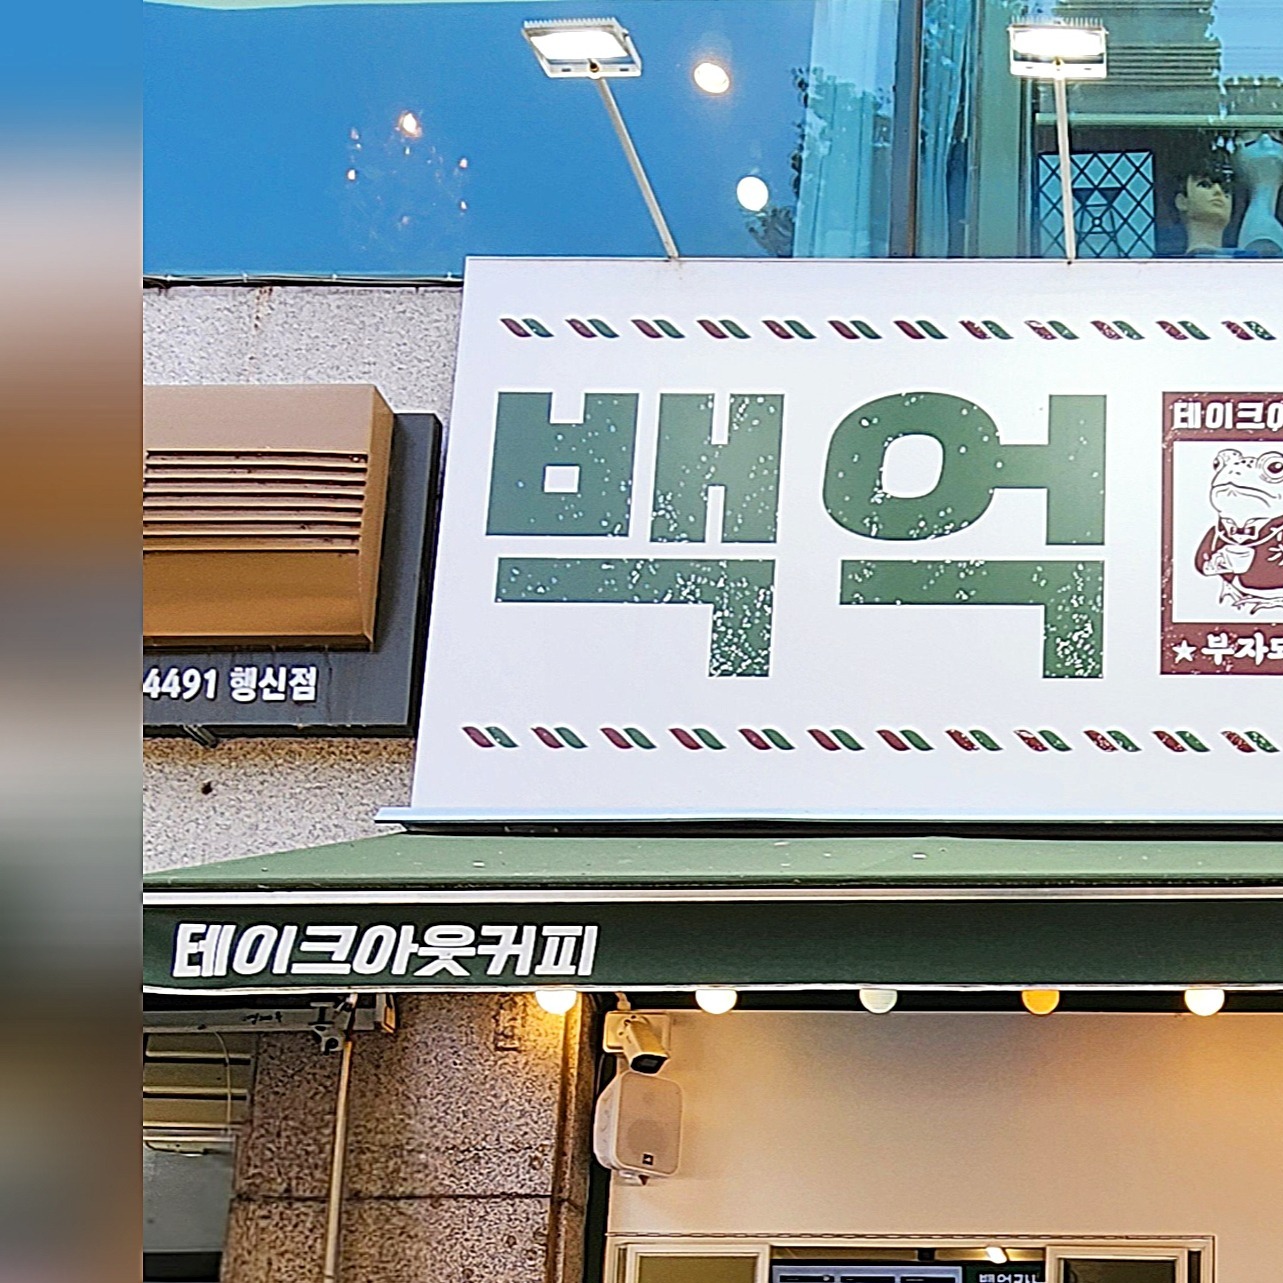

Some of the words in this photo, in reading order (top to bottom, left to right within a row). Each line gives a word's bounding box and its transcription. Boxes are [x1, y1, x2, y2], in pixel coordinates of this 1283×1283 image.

[486, 392, 1106, 679] 백억
[143, 668, 217, 700] 4491
[230, 667, 318, 702] 행신점
[172, 924, 599, 977] 테이크아웃커피
